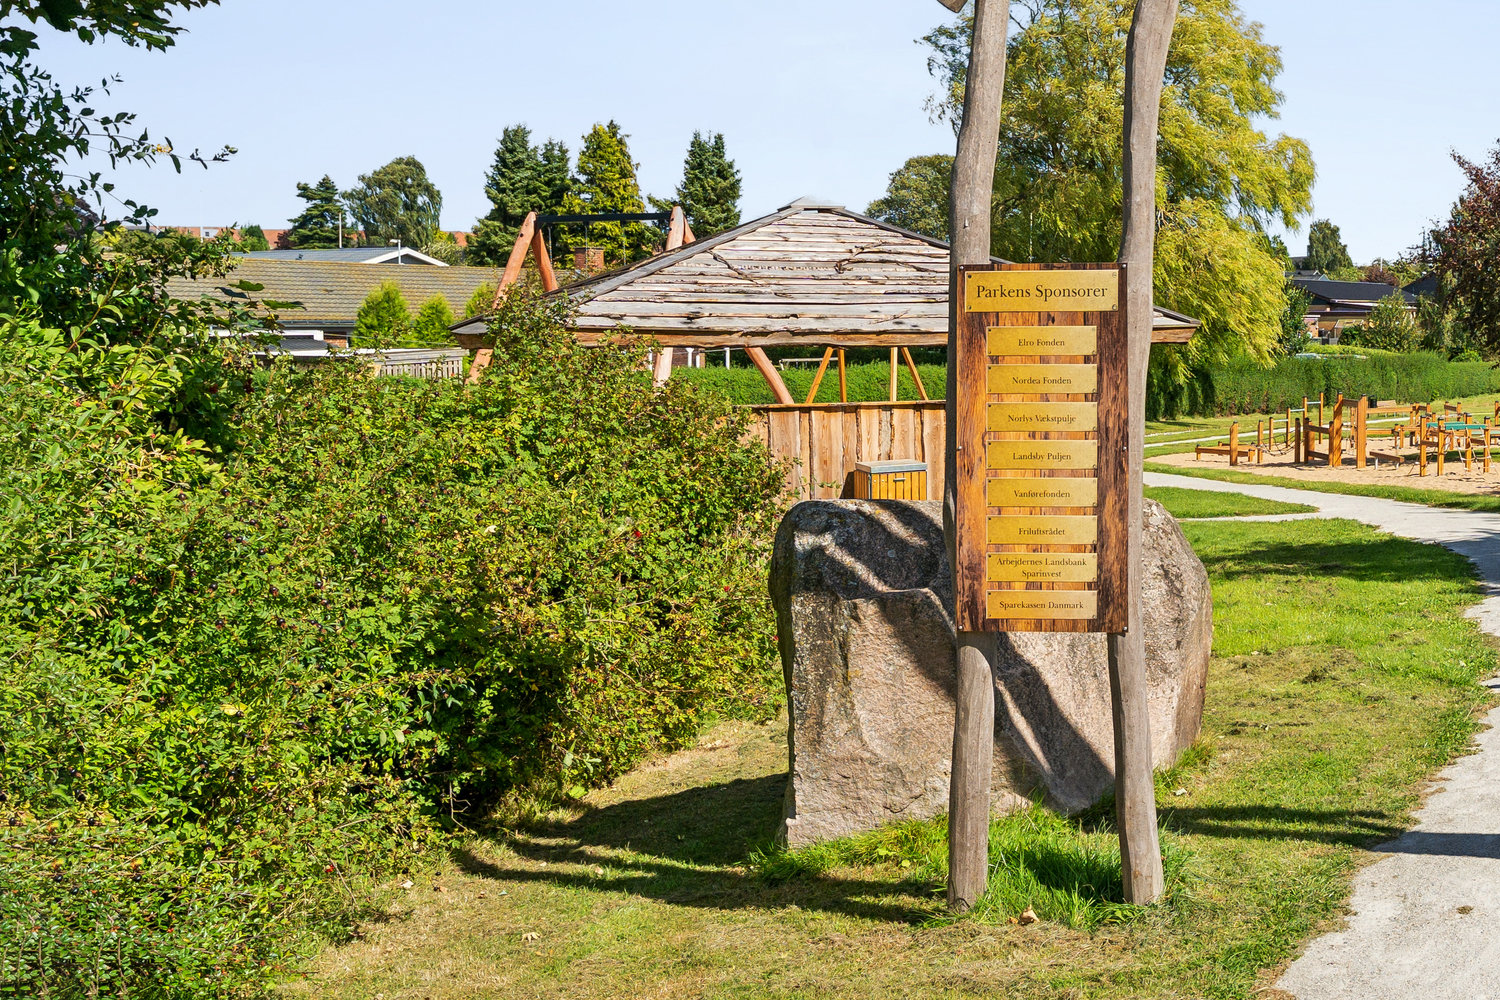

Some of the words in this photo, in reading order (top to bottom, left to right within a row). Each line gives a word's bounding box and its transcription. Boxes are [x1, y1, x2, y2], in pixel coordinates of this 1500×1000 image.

[976, 285, 1031, 298] Parkens
[1035, 284, 1108, 301] Sponsorer
[1018, 339, 1034, 347] Elro
[1037, 339, 1065, 347] Fonden
[1012, 377, 1041, 385] Nordea
[1043, 377, 1072, 385] Fonden
[1008, 415, 1032, 423] Norlys
[1035, 415, 1076, 424] Vækstpulje
[1013, 452, 1044, 462] Landsby
[1047, 452, 1072, 462] Puljen
[1014, 490, 1071, 498] Vanførefonden
[1018, 527, 1065, 535] Friluftsrådet
[997, 558, 1042, 567] Arbejdernes
[1045, 558, 1087, 566] Landsbank
[1022, 570, 1062, 579] Sparinvest
[999, 601, 1046, 610] Sparekassen
